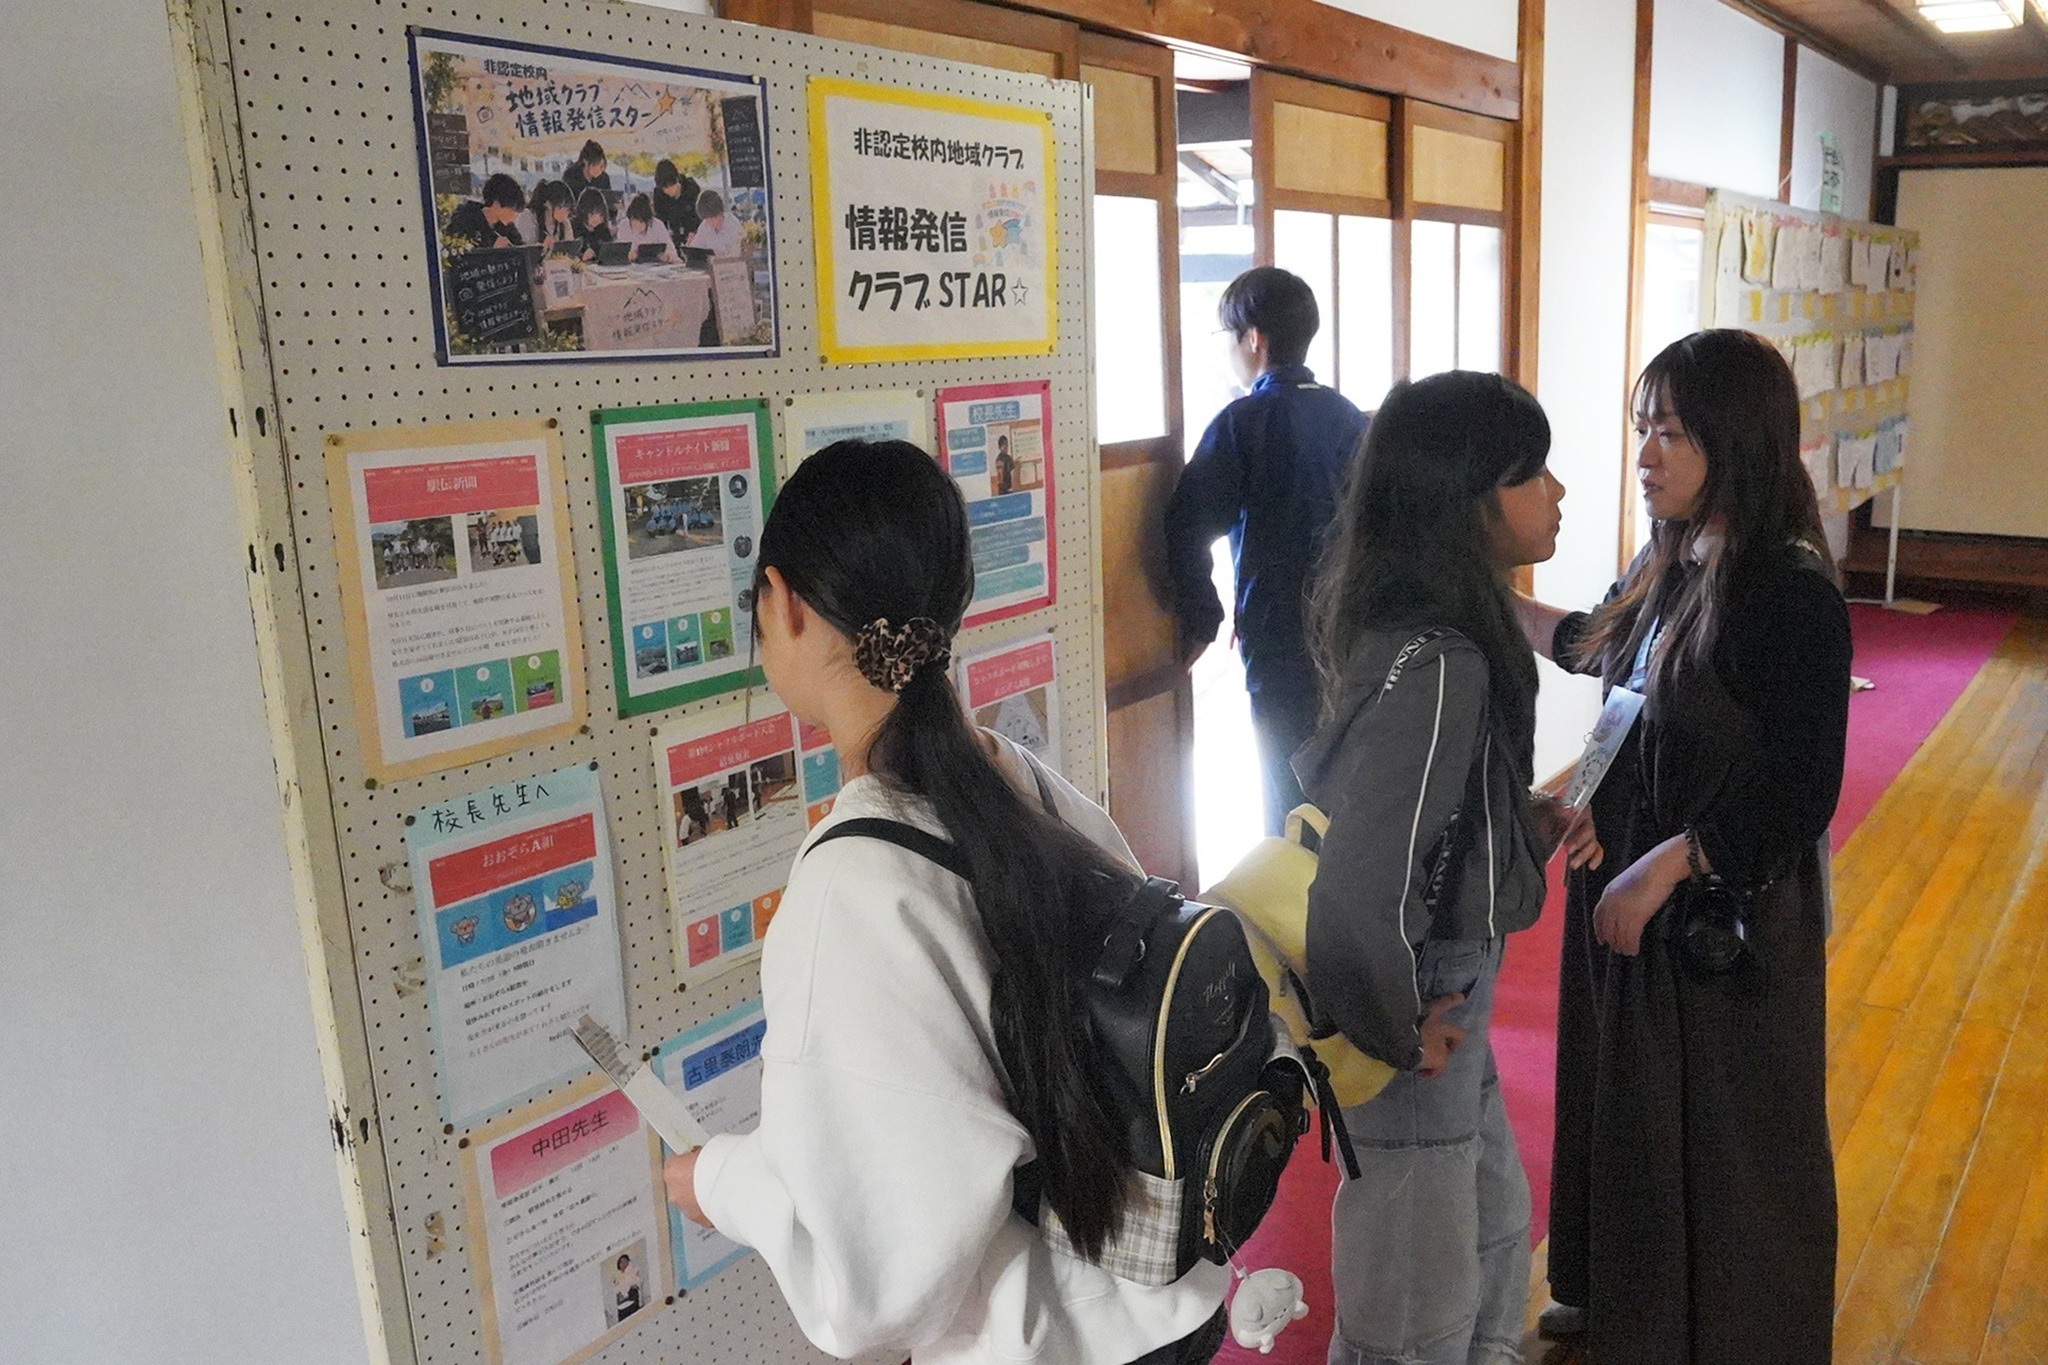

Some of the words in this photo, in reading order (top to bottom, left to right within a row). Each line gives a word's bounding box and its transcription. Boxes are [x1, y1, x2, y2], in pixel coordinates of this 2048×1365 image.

[484, 59, 547, 81] 非認定校内
[506, 78, 604, 113] 地域クラブ
[515, 106, 653, 138] 情報発信スター
[853, 127, 1025, 170] 非認定校内地域クラブ
[845, 204, 968, 253] 情報発信
[973, 402, 1020, 422] 校長先生
[432, 783, 551, 835] 校長先生へ
[531, 1109, 610, 1159] 中田先生
